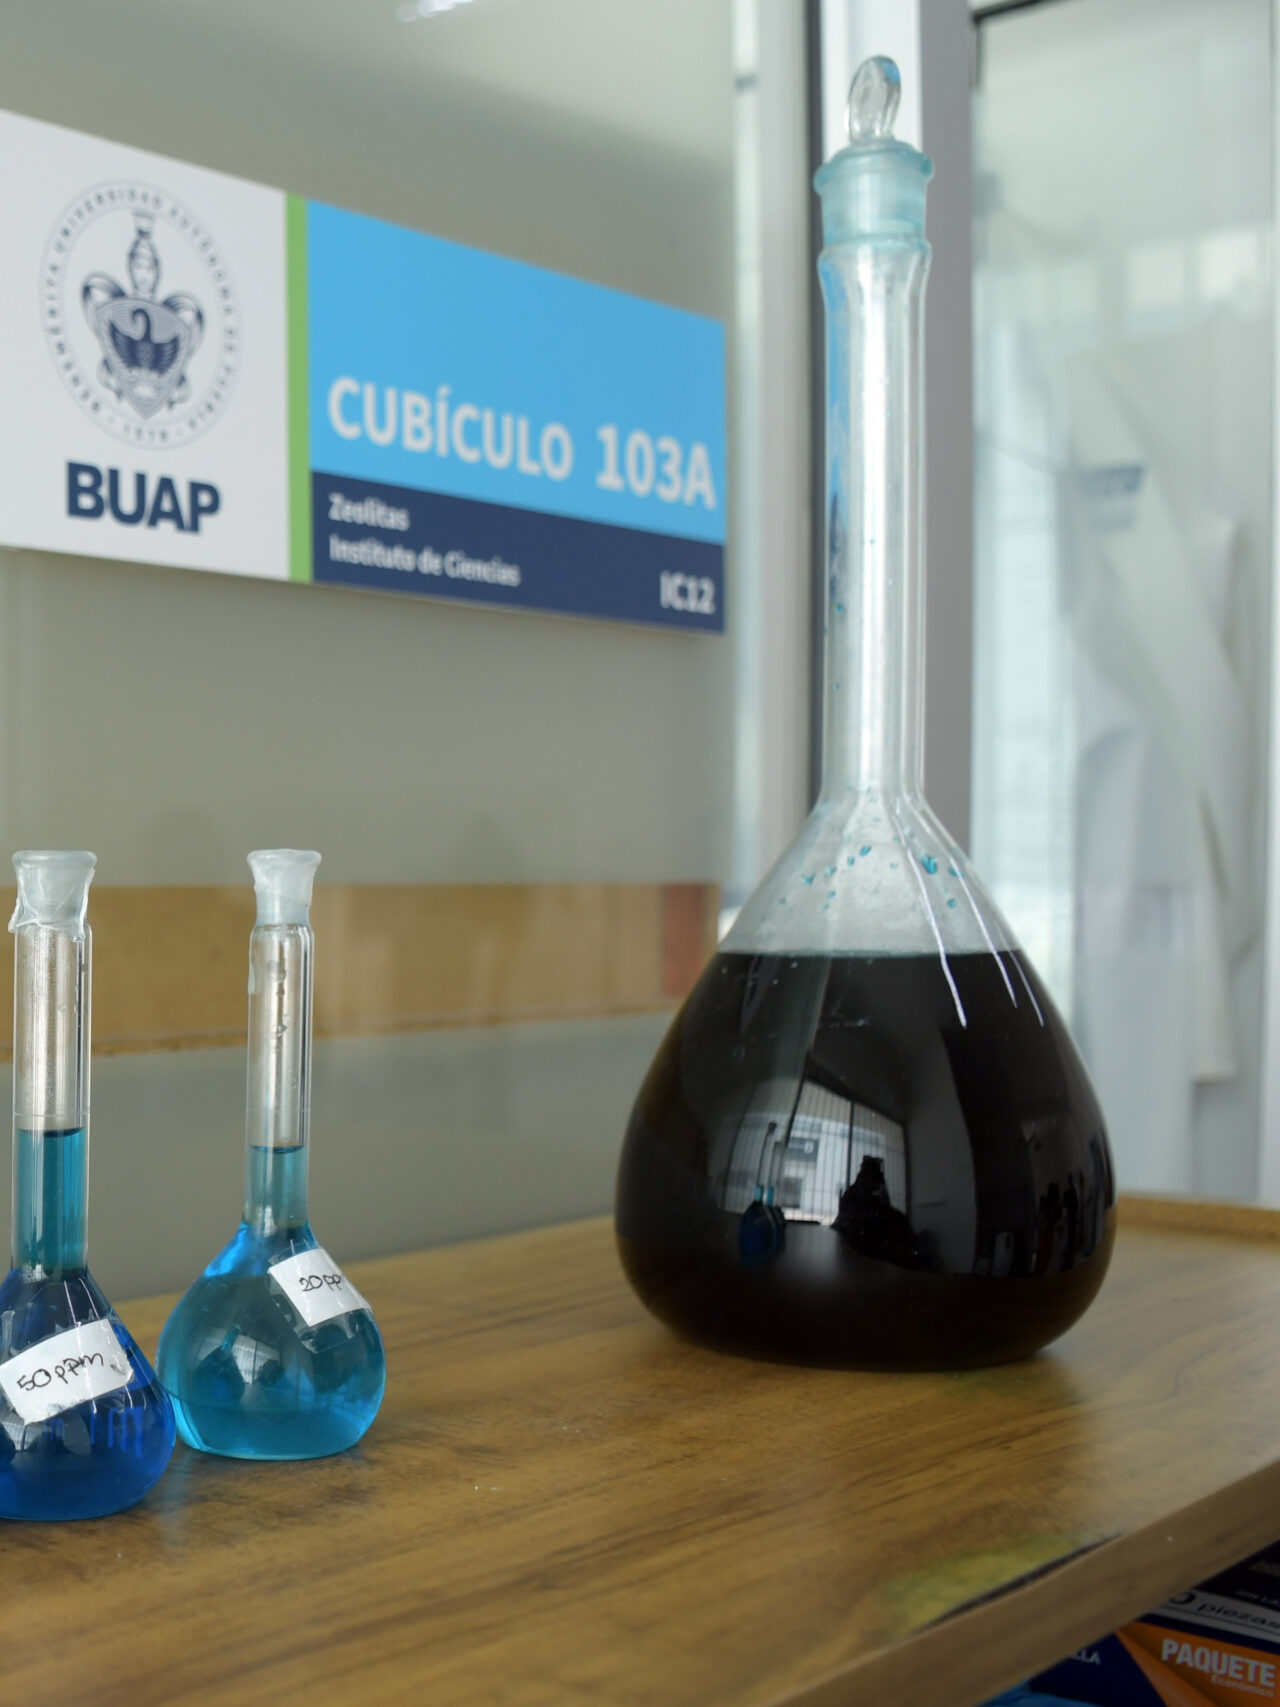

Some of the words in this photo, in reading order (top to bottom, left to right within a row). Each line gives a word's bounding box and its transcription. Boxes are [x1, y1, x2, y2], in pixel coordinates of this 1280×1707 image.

[327, 376, 575, 481] CUBÍCULO
[595, 422, 718, 510] 103A
[66, 459, 221, 535] BUAP
[328, 492, 411, 532] Zeolitas
[329, 534, 417, 571] Instituto
[418, 547, 443, 577] de
[444, 550, 522, 588] Ciencias
[658, 570, 716, 615] IC12
[1160, 1637, 1277, 1689] PAQUETE
